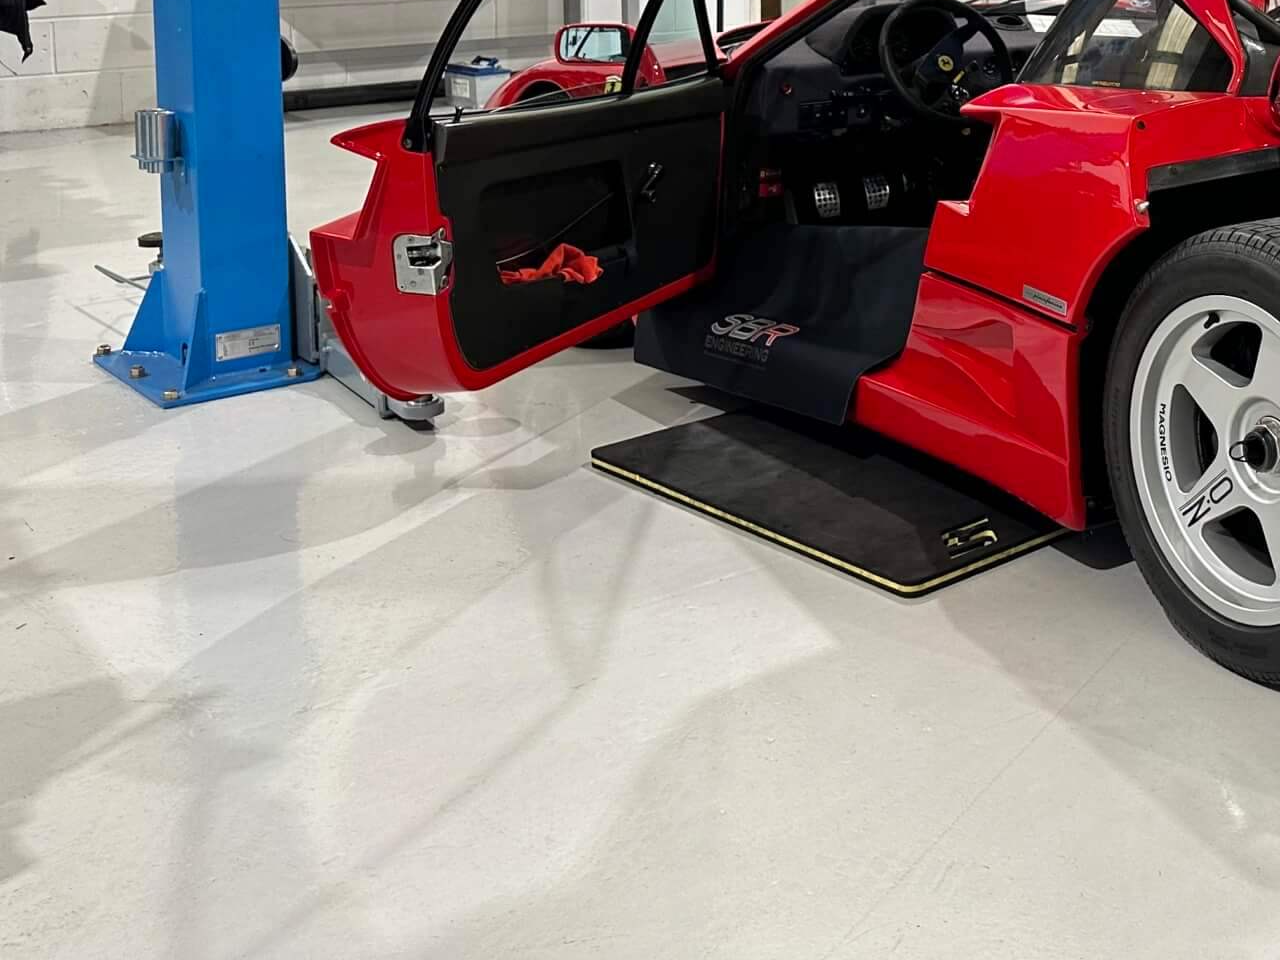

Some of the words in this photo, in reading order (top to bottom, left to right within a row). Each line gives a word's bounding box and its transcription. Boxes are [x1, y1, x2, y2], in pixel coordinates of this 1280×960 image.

[711, 313, 800, 347] SBR
[704, 334, 769, 362] ENGINEERING
[1158, 402, 1172, 482] MAGNESIO
